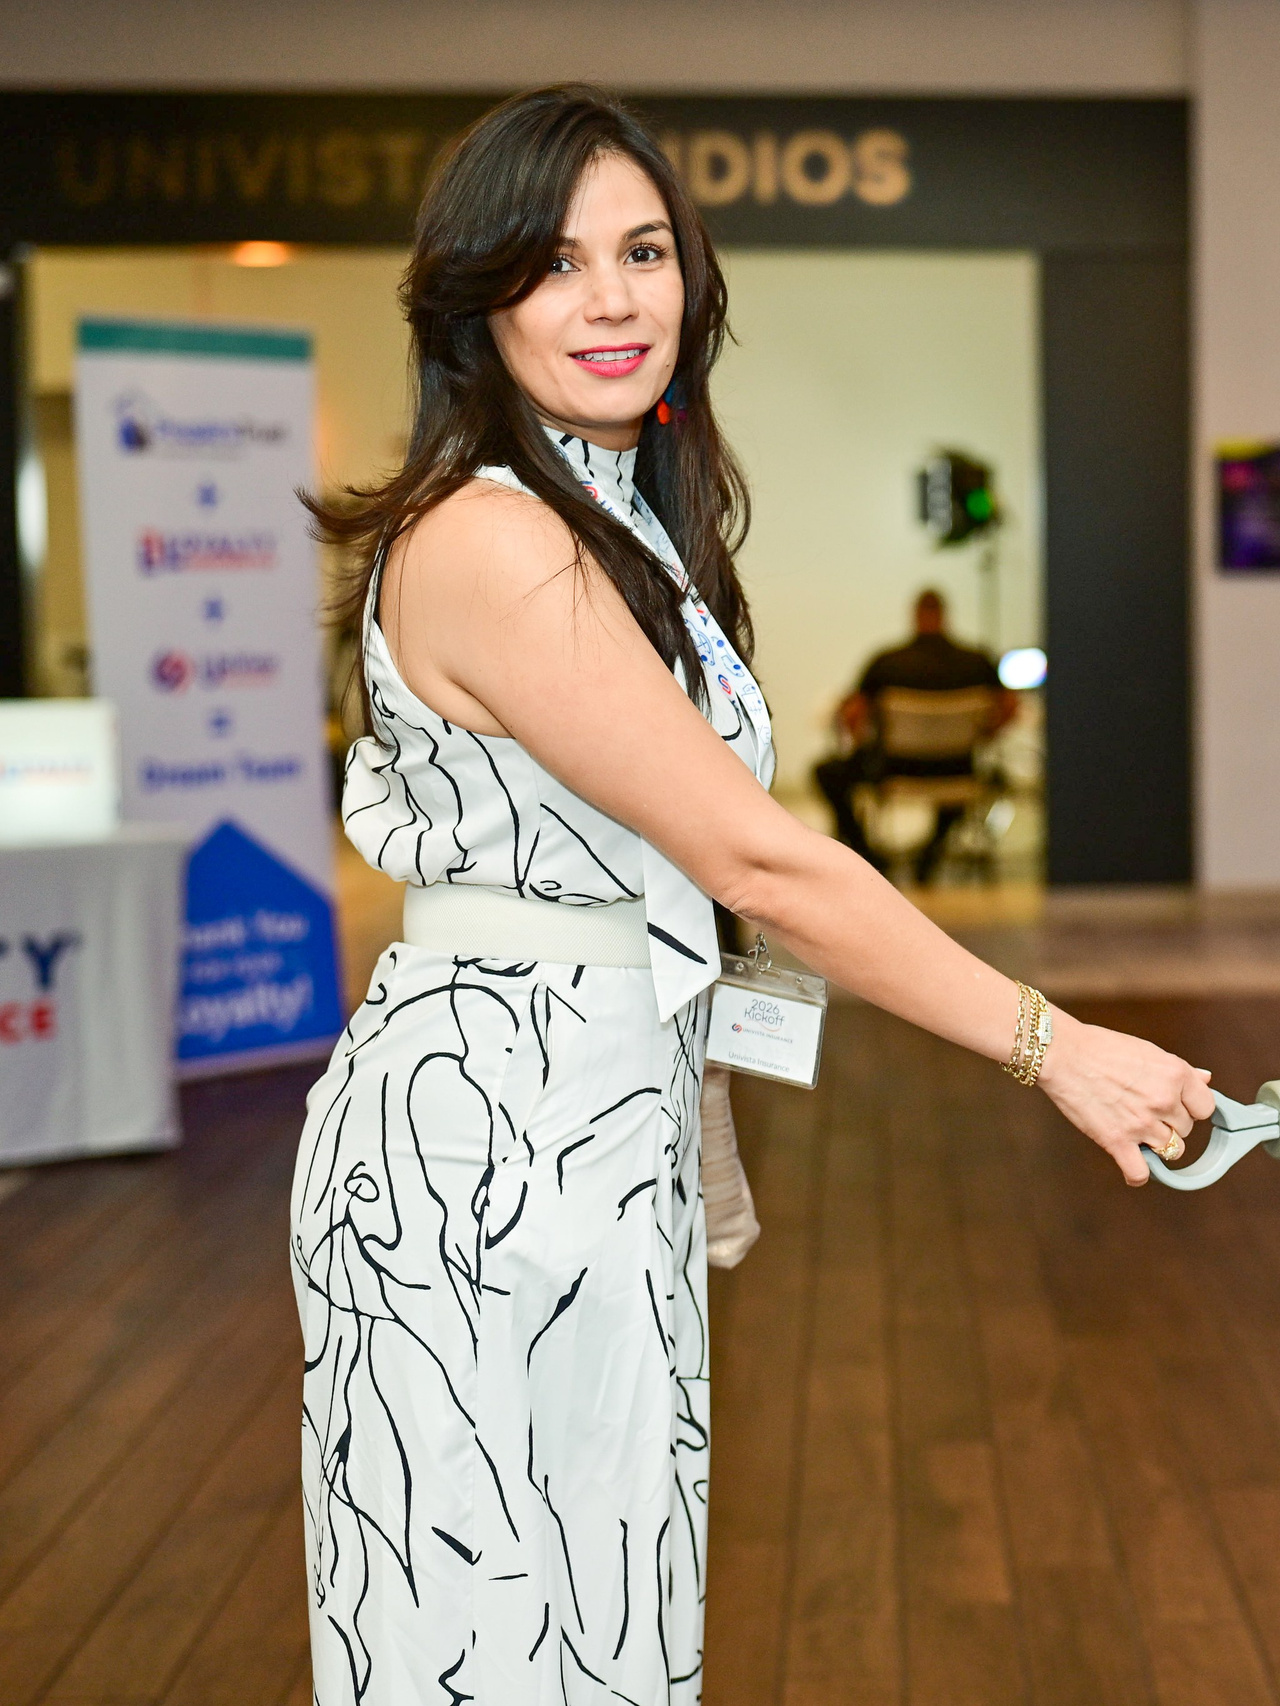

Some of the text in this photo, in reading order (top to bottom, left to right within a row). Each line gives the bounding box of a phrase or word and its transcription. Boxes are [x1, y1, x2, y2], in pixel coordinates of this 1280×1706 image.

[56, 126, 910, 206] UNIVIST DIOS
[751, 999, 780, 1015] 2026
[744, 1008, 785, 1027] Kickoff
[757, 1058, 790, 1073] Insurance
